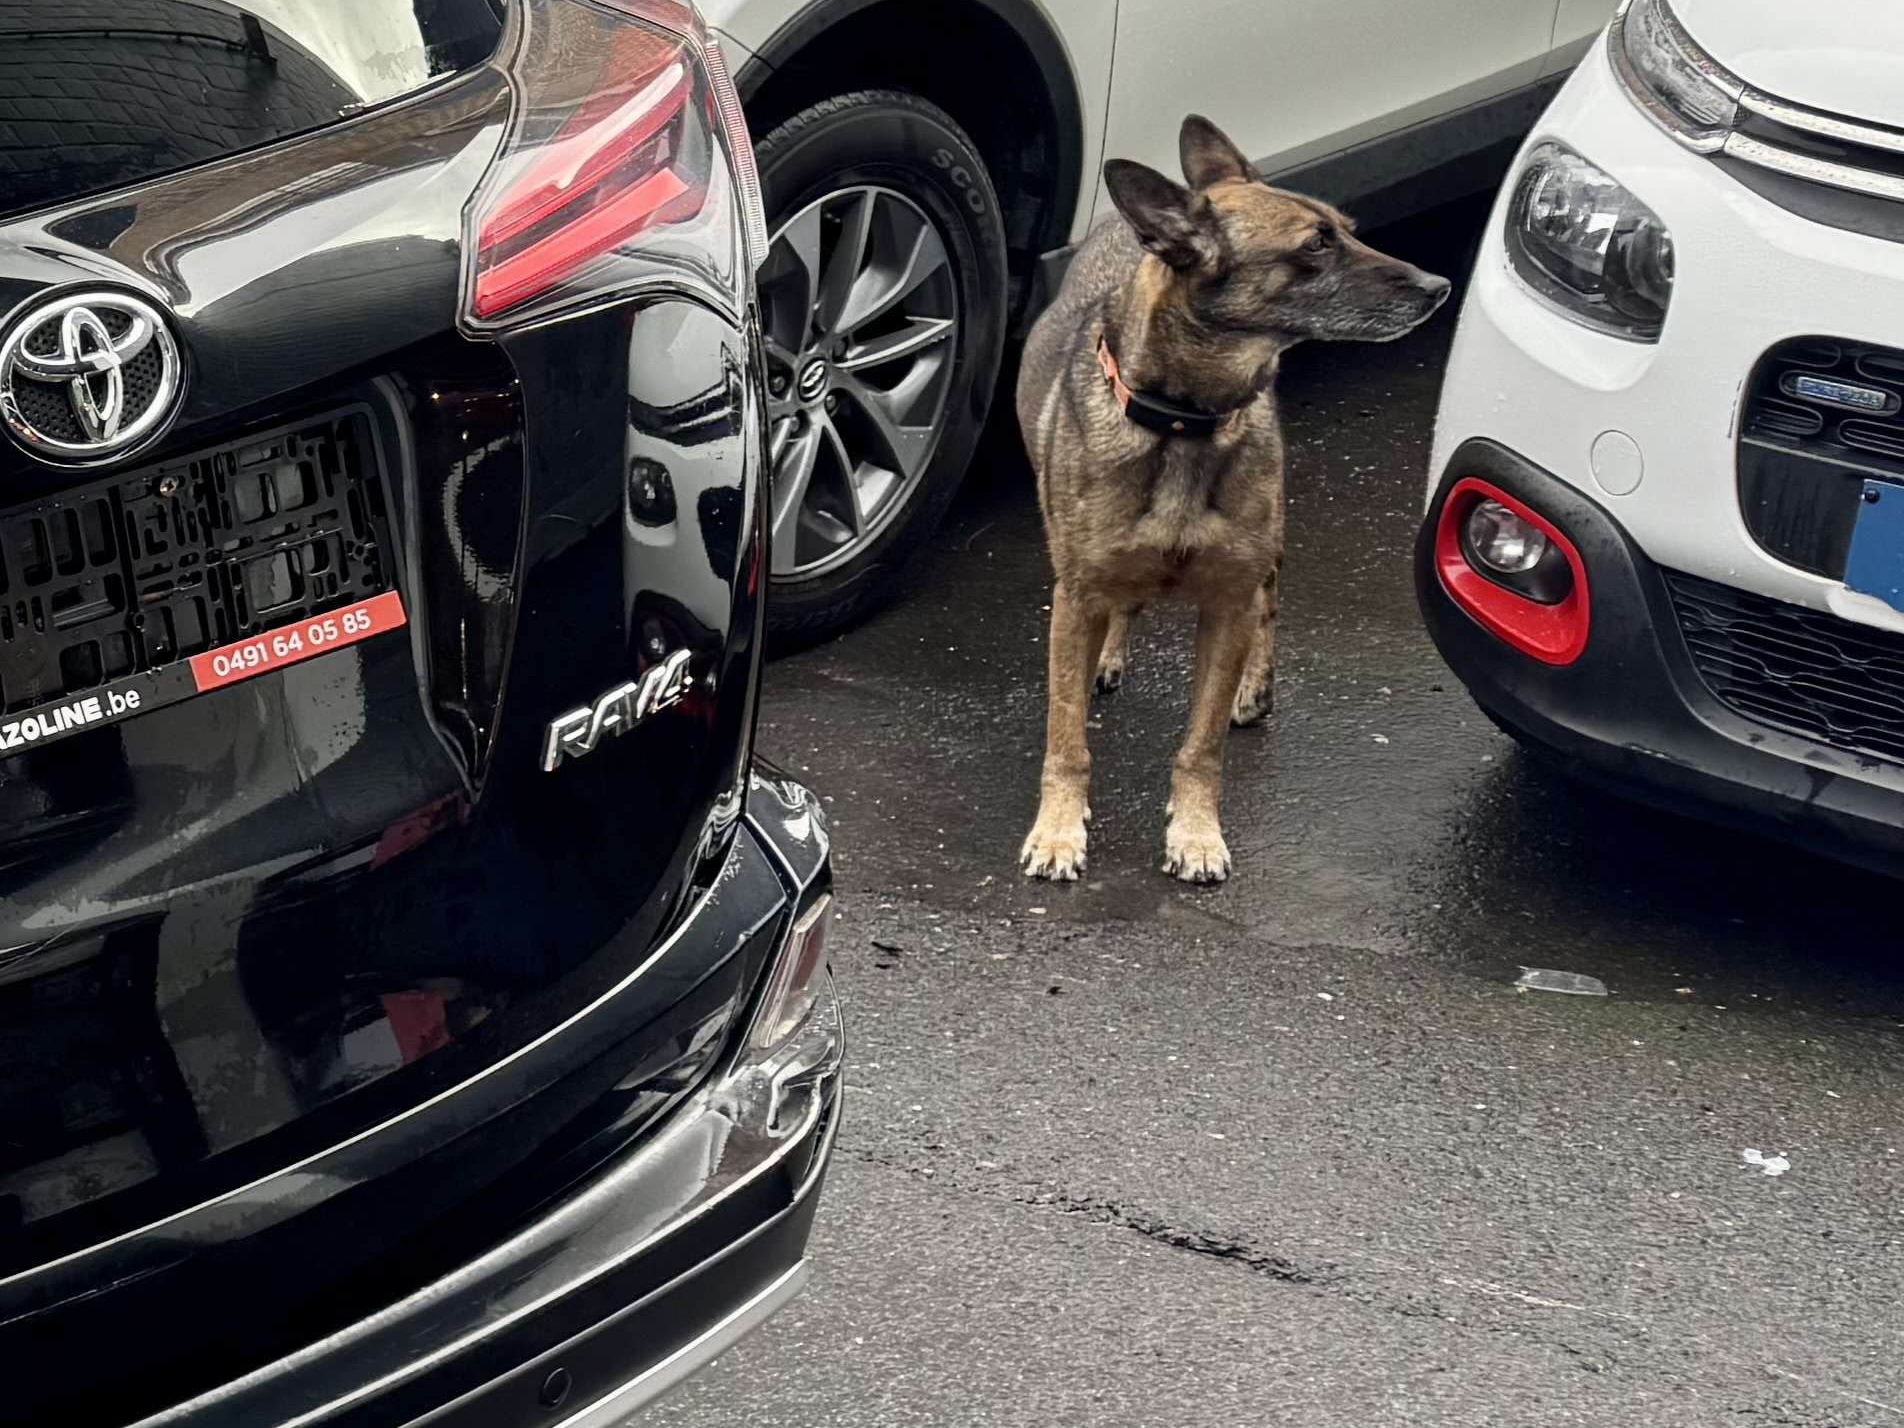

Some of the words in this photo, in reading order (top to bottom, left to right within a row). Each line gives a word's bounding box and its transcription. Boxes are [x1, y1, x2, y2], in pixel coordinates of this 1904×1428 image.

[213, 644, 269, 677] 0491
[273, 632, 303, 657] 64
[307, 619, 338, 645] 05
[342, 608, 371, 634] 85
